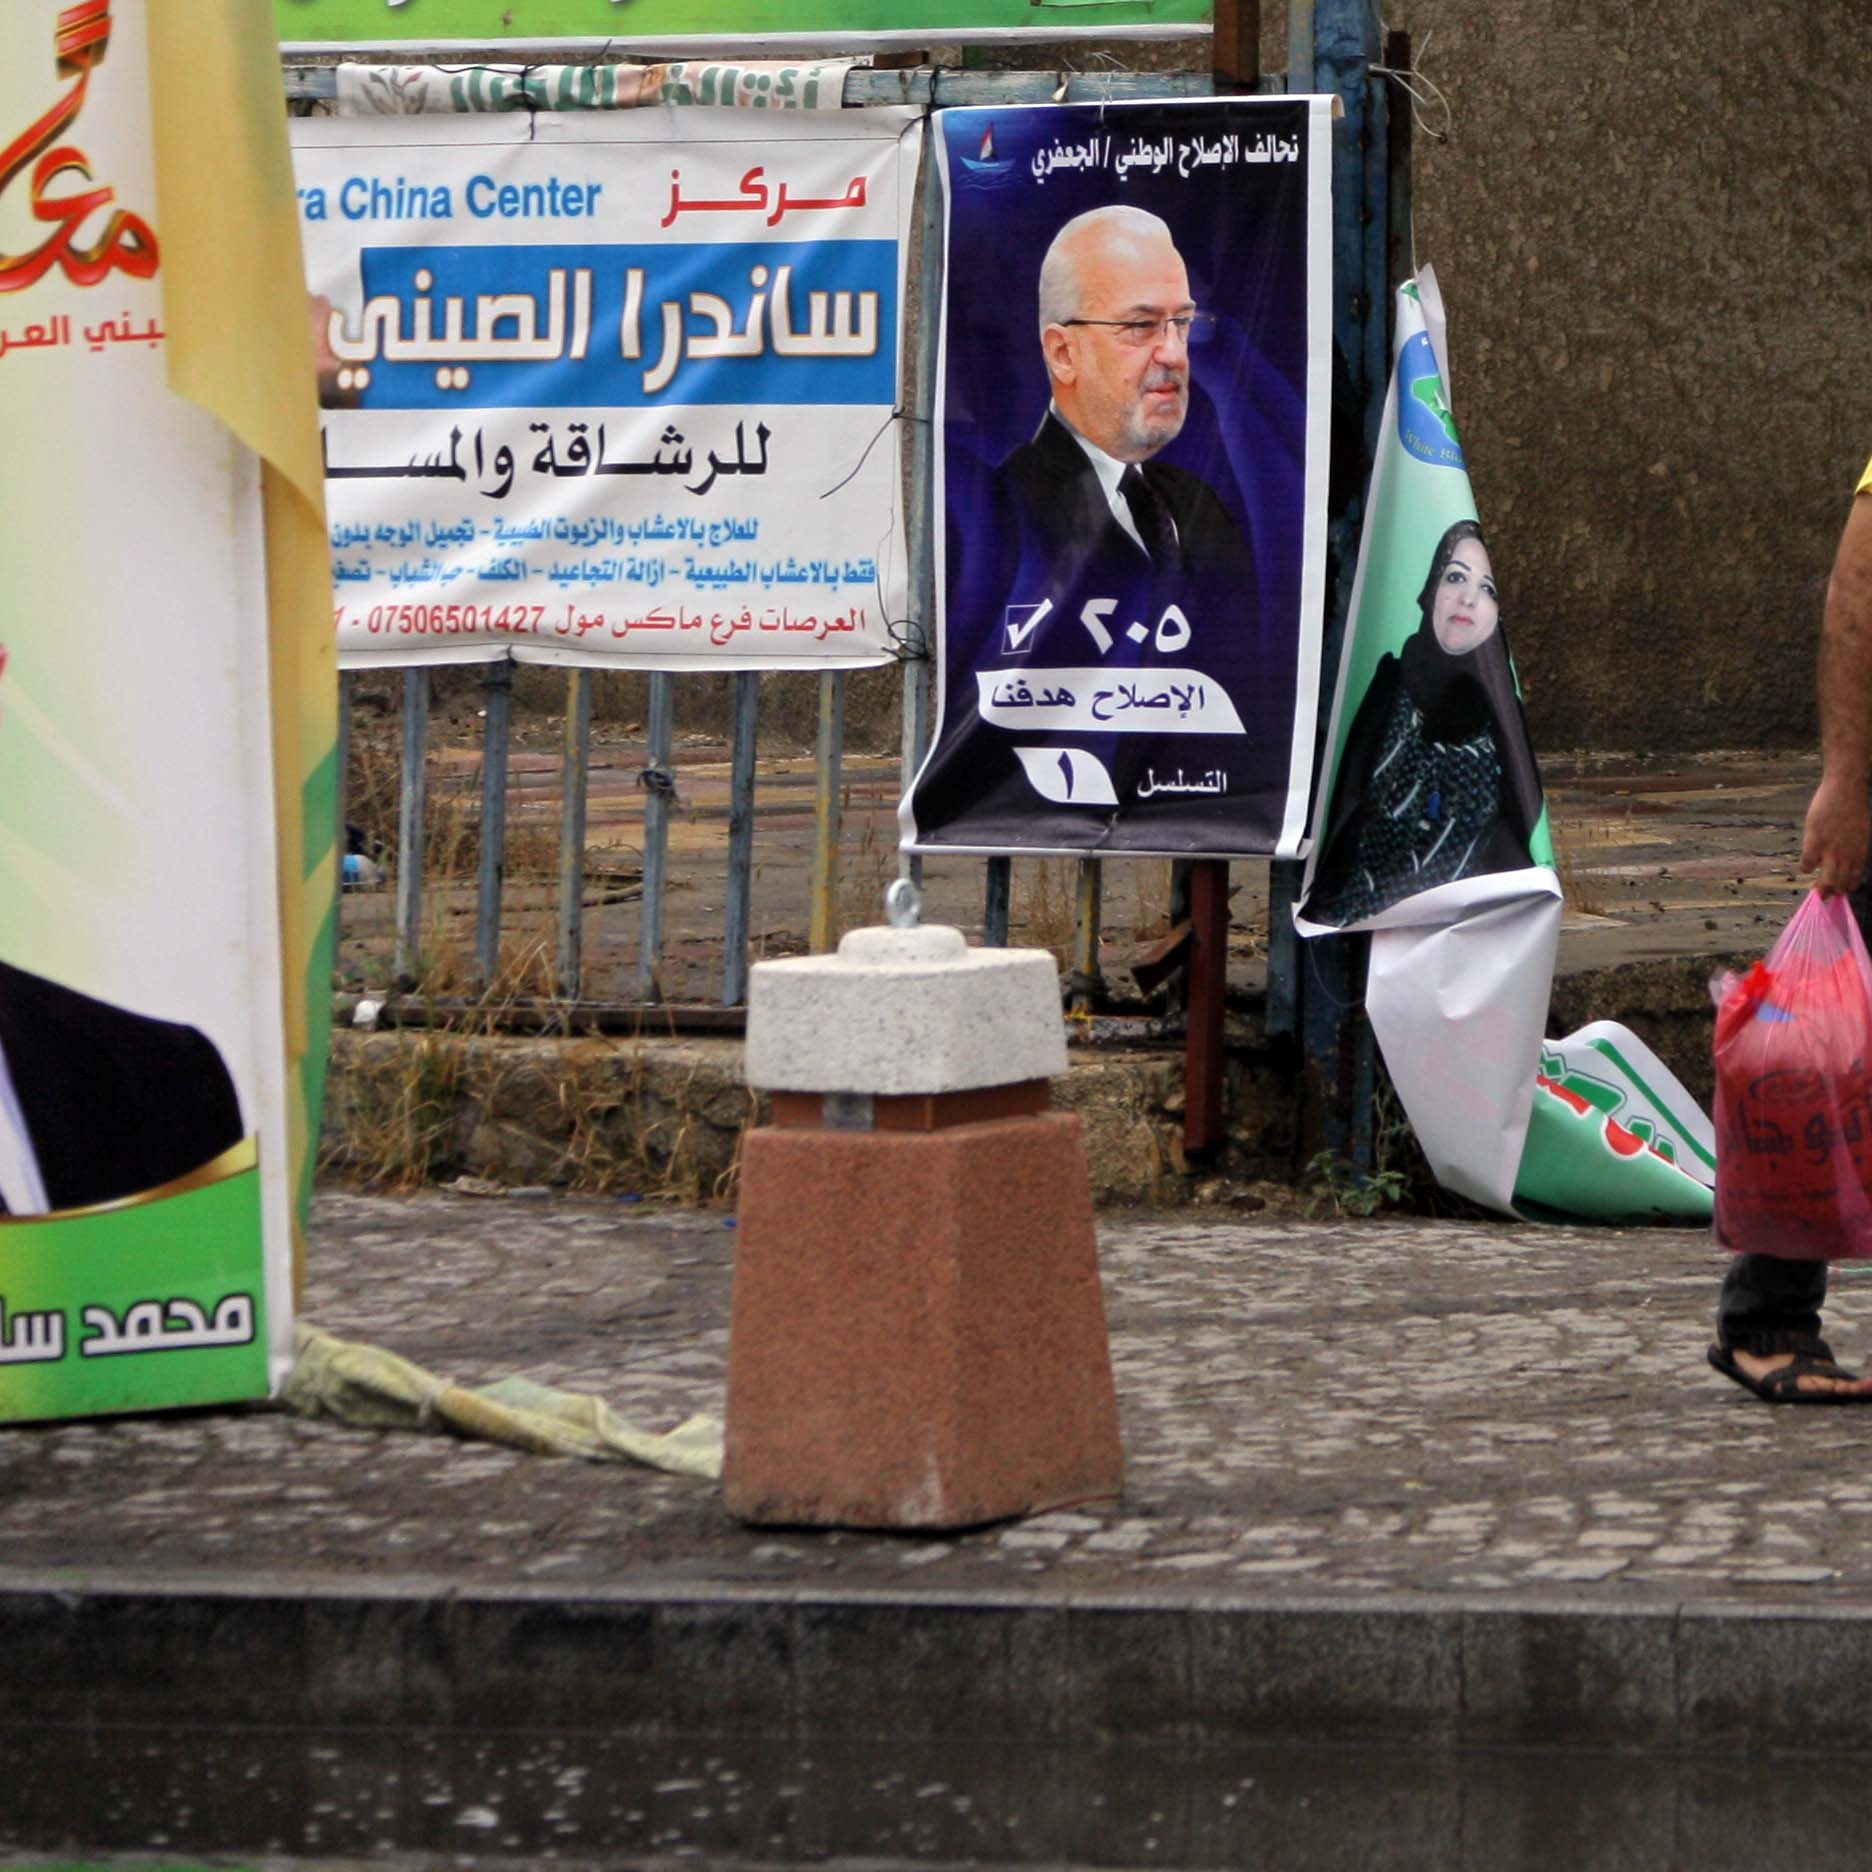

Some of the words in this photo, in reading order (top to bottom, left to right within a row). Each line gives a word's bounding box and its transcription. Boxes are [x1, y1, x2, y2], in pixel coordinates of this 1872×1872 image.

[1031, 138, 1101, 184] الجعفري
[1114, 136, 1174, 182] الوطني
[339, 175, 452, 221] China
[465, 174, 602, 219] Center
[661, 165, 869, 228] مركز
[83, 310, 166, 352] بني
[329, 267, 594, 391] الصيني
[619, 264, 879, 394] ساندرا
[321, 420, 516, 500] والمسا
[530, 420, 772, 497] للرشاقة
[425, 516, 475, 549] تجميل
[627, 512, 705, 549] بالاعشاب
[709, 516, 760, 548] للعلاج
[548, 558, 623, 588] التجاعيد
[684, 554, 758, 590] الطبيعية
[760, 556, 839, 591] بالاعشاب
[366, 604, 545, 635] 07506501427
[554, 604, 605, 638] مول
[611, 605, 703, 639] ماكس
[709, 605, 754, 646] فرع
[759, 607, 866, 641] العرصات
[1079, 597, 1192, 656] ٢٠٥
[990, 678, 1077, 709] هدفنا
[1136, 768, 1228, 798] التسلسل
[82, 1290, 255, 1359] محمد
